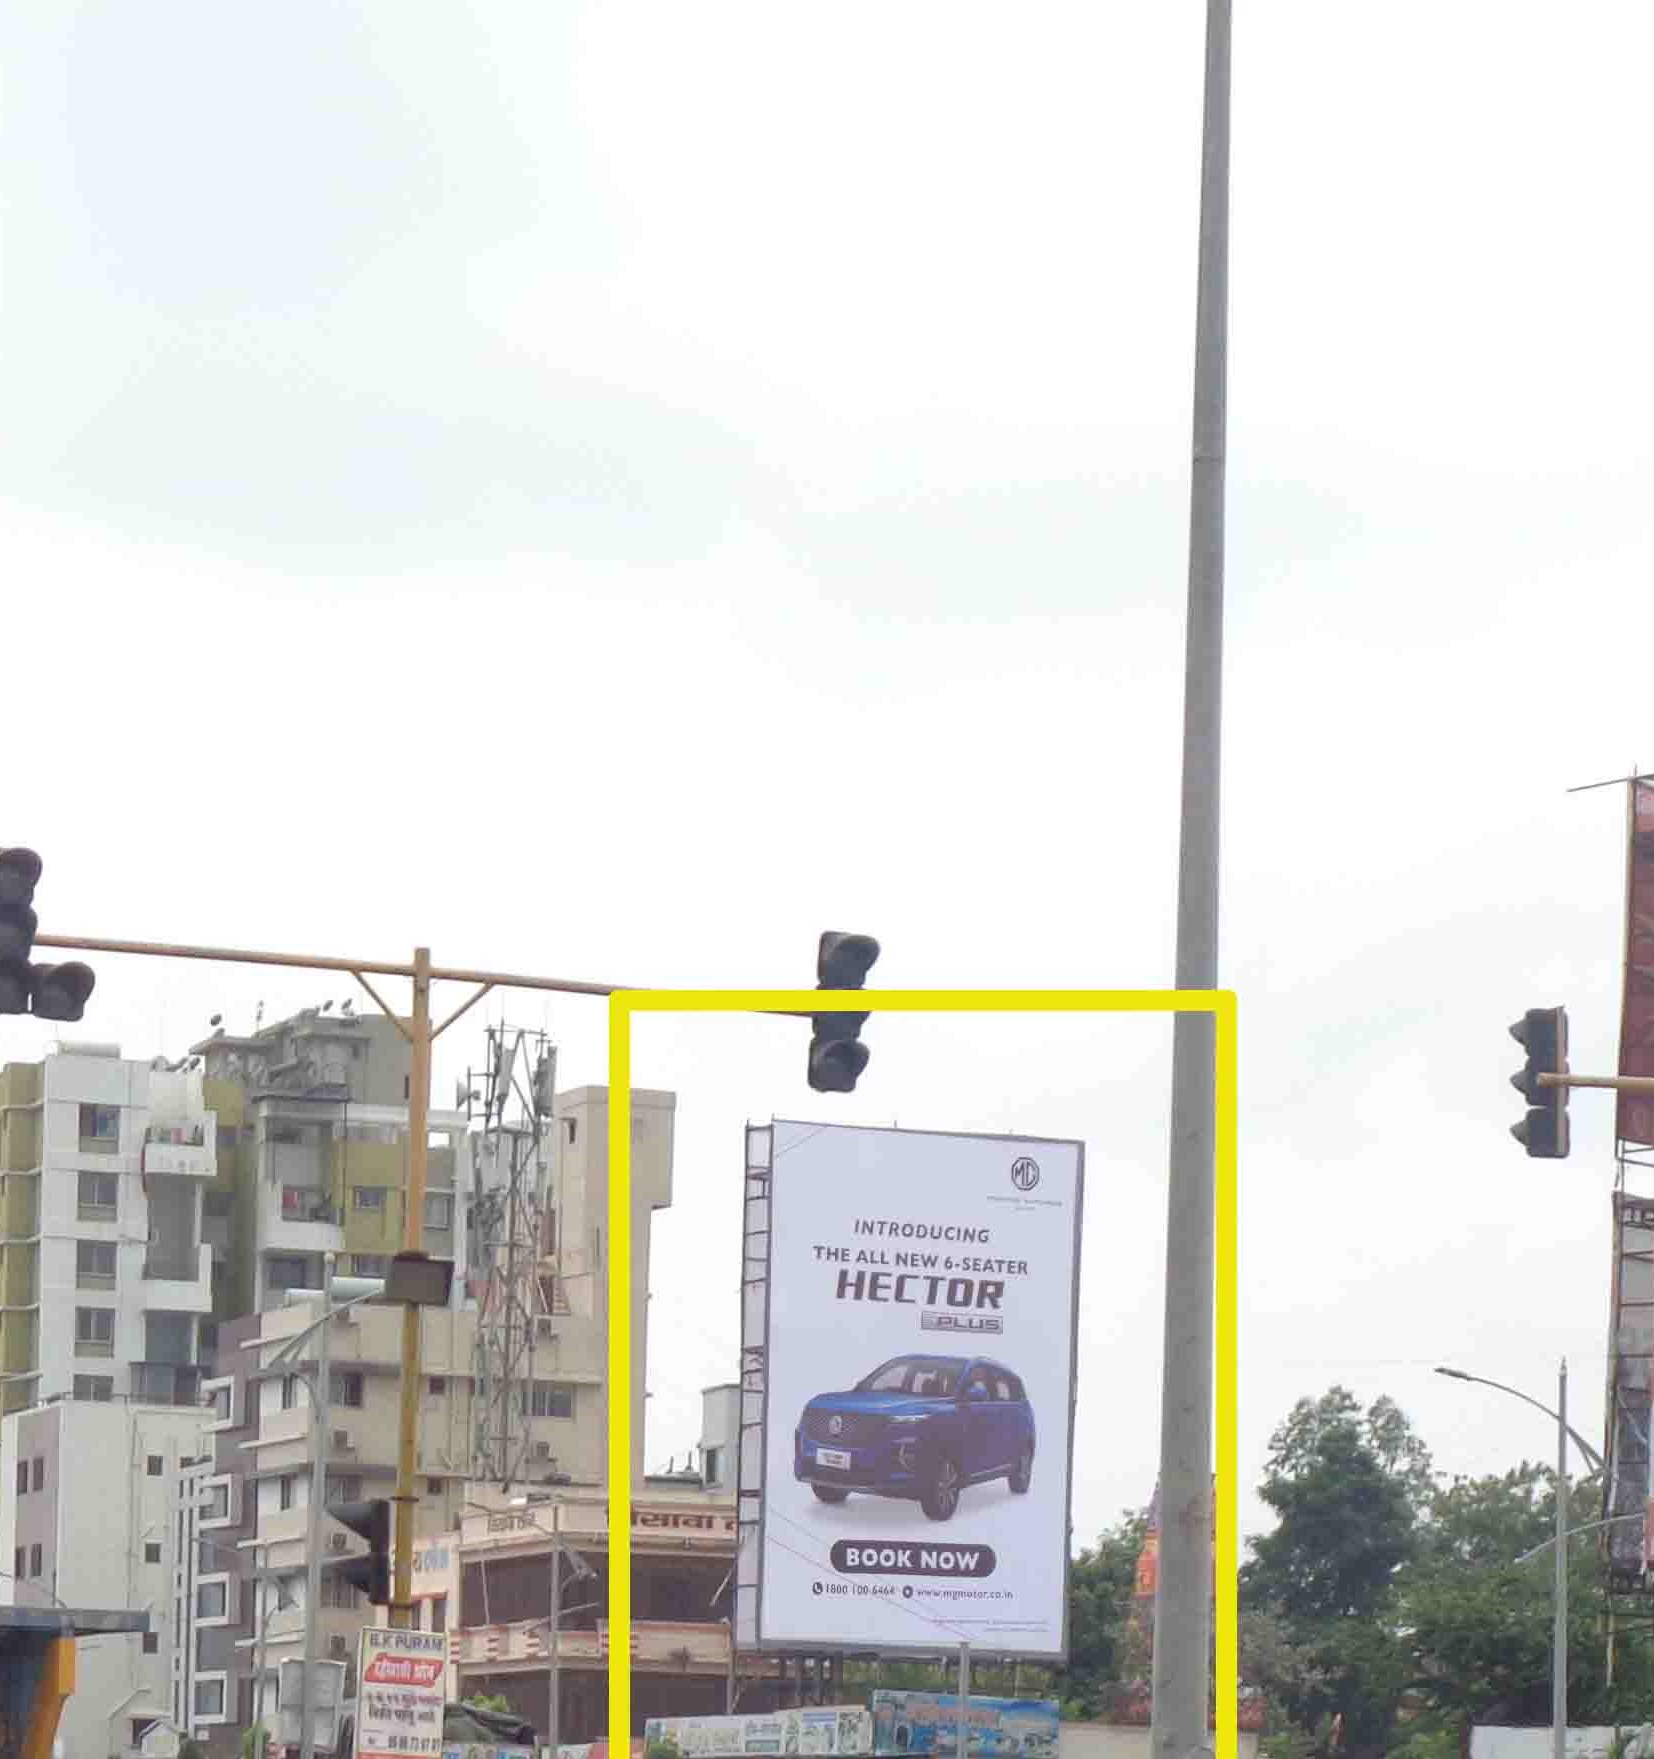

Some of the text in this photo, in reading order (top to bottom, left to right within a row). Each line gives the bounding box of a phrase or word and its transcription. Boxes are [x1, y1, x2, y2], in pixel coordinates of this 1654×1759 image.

[853, 1218, 990, 1243] INTRODUCING
[813, 1246, 1028, 1276] THE ALL NEW 6-SEATER
[836, 1269, 1005, 1309] HECTOR
[935, 1315, 1000, 1331] PLUS
[846, 1548, 979, 1571] BOOK NOW
[826, 1582, 848, 1594] 1800
[917, 1589, 1014, 1601] www.mgmotor.co.in
